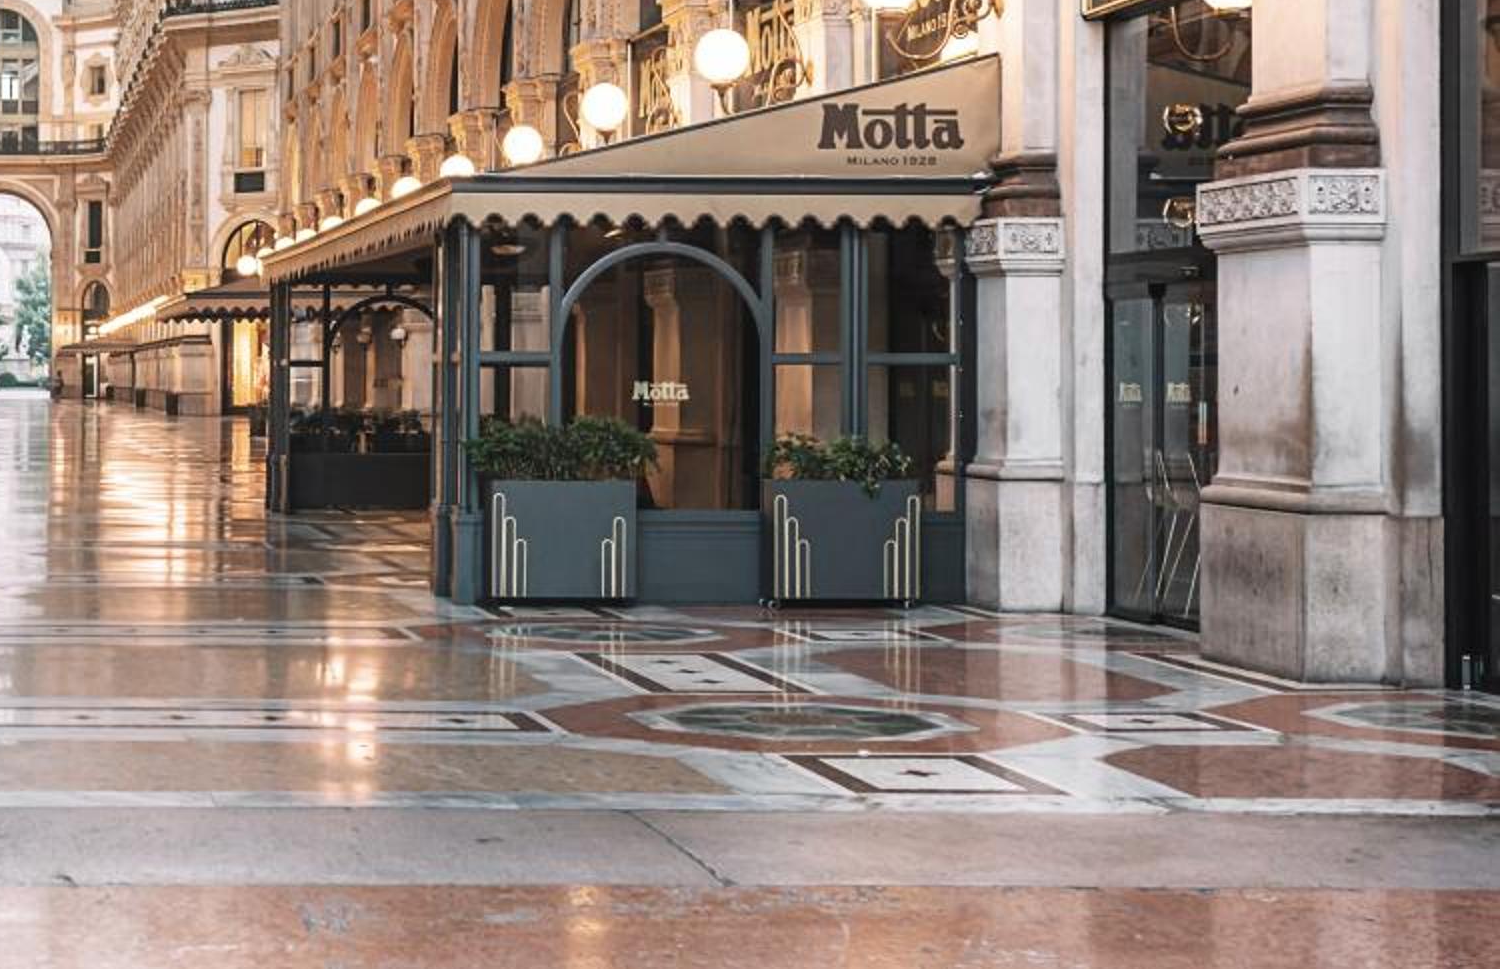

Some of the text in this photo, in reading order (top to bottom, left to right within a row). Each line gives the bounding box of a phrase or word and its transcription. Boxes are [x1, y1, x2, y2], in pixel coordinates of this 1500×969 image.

[818, 103, 964, 150] Motta
[847, 155, 938, 167] MILANO 1928
[632, 381, 690, 400] Motta
